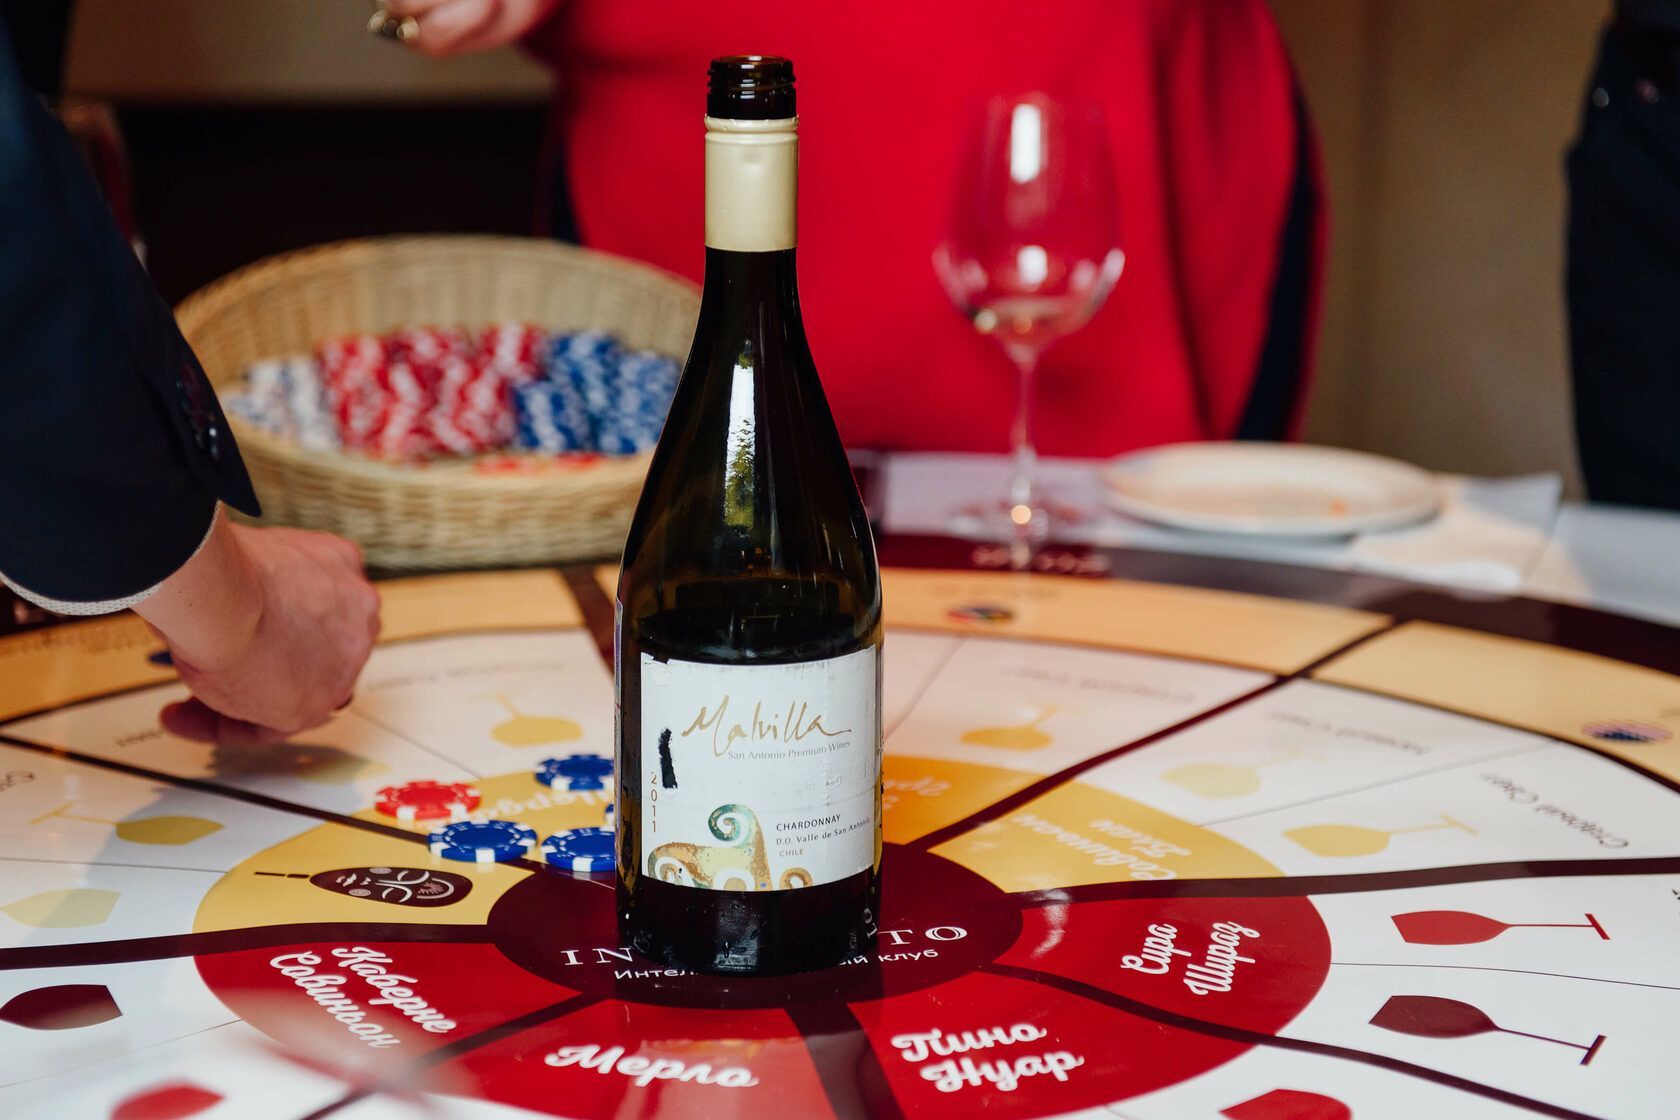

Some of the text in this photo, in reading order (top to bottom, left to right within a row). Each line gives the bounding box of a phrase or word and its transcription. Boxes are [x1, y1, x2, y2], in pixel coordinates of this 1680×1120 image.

[681, 694, 852, 758] Malvilla
[728, 740, 851, 760] San Antonio Premium Wines
[776, 814, 842, 832] CHARDONNAY
[776, 818, 871, 846] D.O. Valle de San Antonio
[779, 848, 805, 857] CHILE
[878, 949, 939, 962] клуб
[1121, 923, 1193, 975] Сира
[1184, 920, 1261, 996] Шираз
[330, 945, 458, 1035] Каберне
[890, 1022, 1048, 1063] Пино
[544, 1043, 760, 1088] Мерло
[919, 1050, 1085, 1093] Нуар
